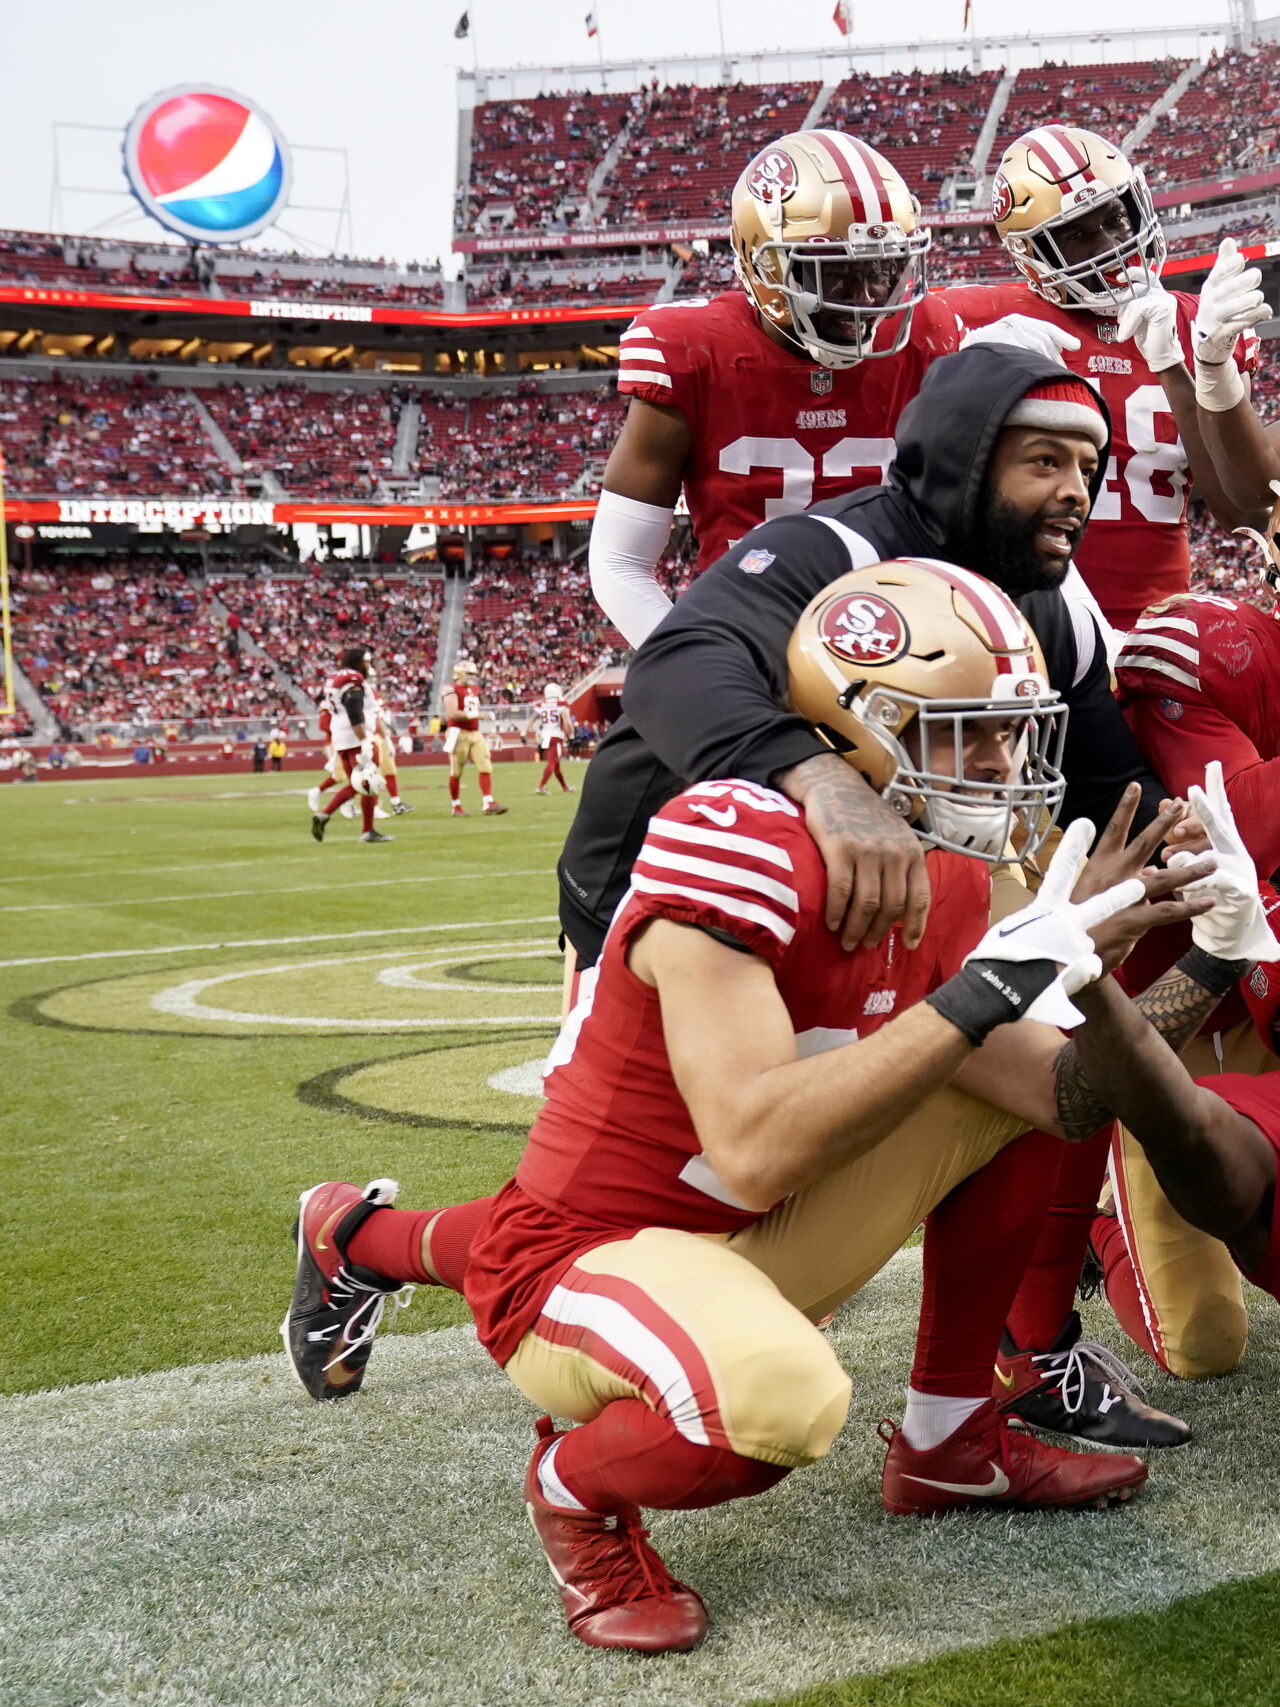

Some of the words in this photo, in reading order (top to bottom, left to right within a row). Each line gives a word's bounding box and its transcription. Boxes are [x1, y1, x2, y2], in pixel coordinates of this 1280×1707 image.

[571, 234, 596, 245] NEED
[665, 228, 689, 240] TEXT
[250, 300, 372, 322] INTERCEPTION
[1088, 355, 1132, 374] 49ERS
[796, 409, 847, 429] 49ERS
[58, 500, 275, 523] INTERCEPTION
[38, 526, 92, 538] TOYOTA
[541, 709, 559, 724] 85
[981, 969, 1004, 990] John
